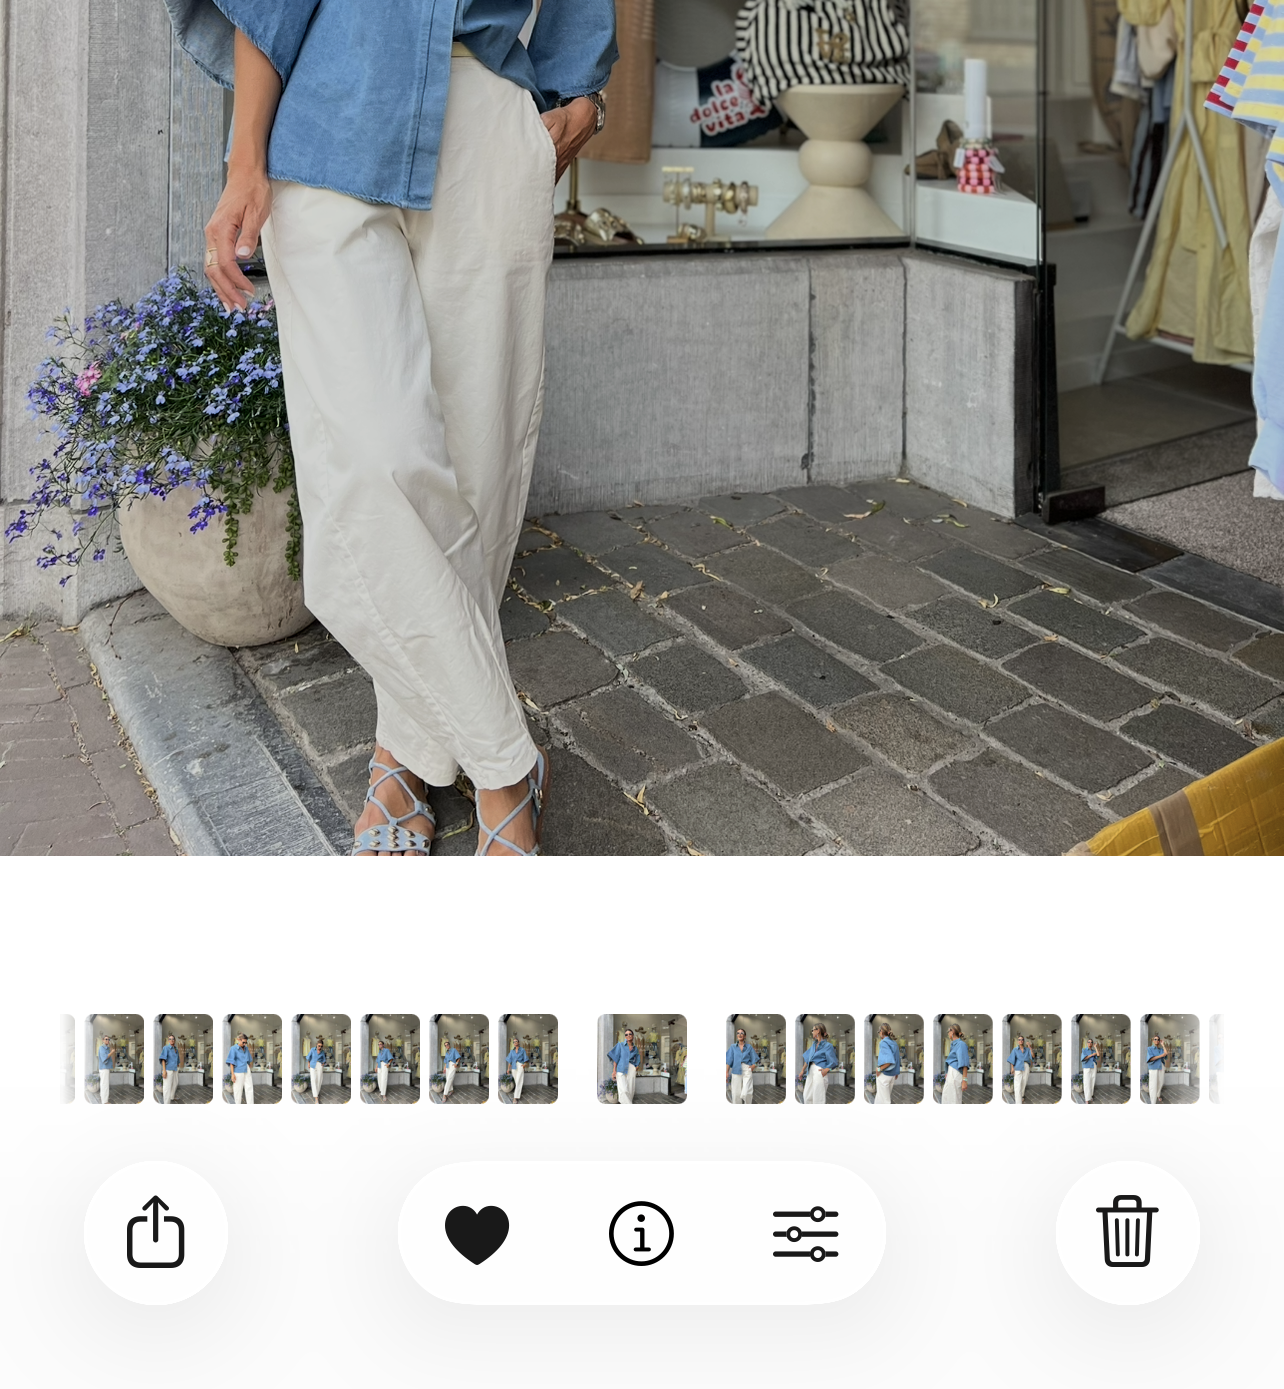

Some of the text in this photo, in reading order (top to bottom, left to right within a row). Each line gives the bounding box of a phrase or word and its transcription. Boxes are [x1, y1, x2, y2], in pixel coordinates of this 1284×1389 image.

[715, 83, 734, 97] la
[690, 96, 739, 123] dolce
[705, 111, 745, 133] vita
